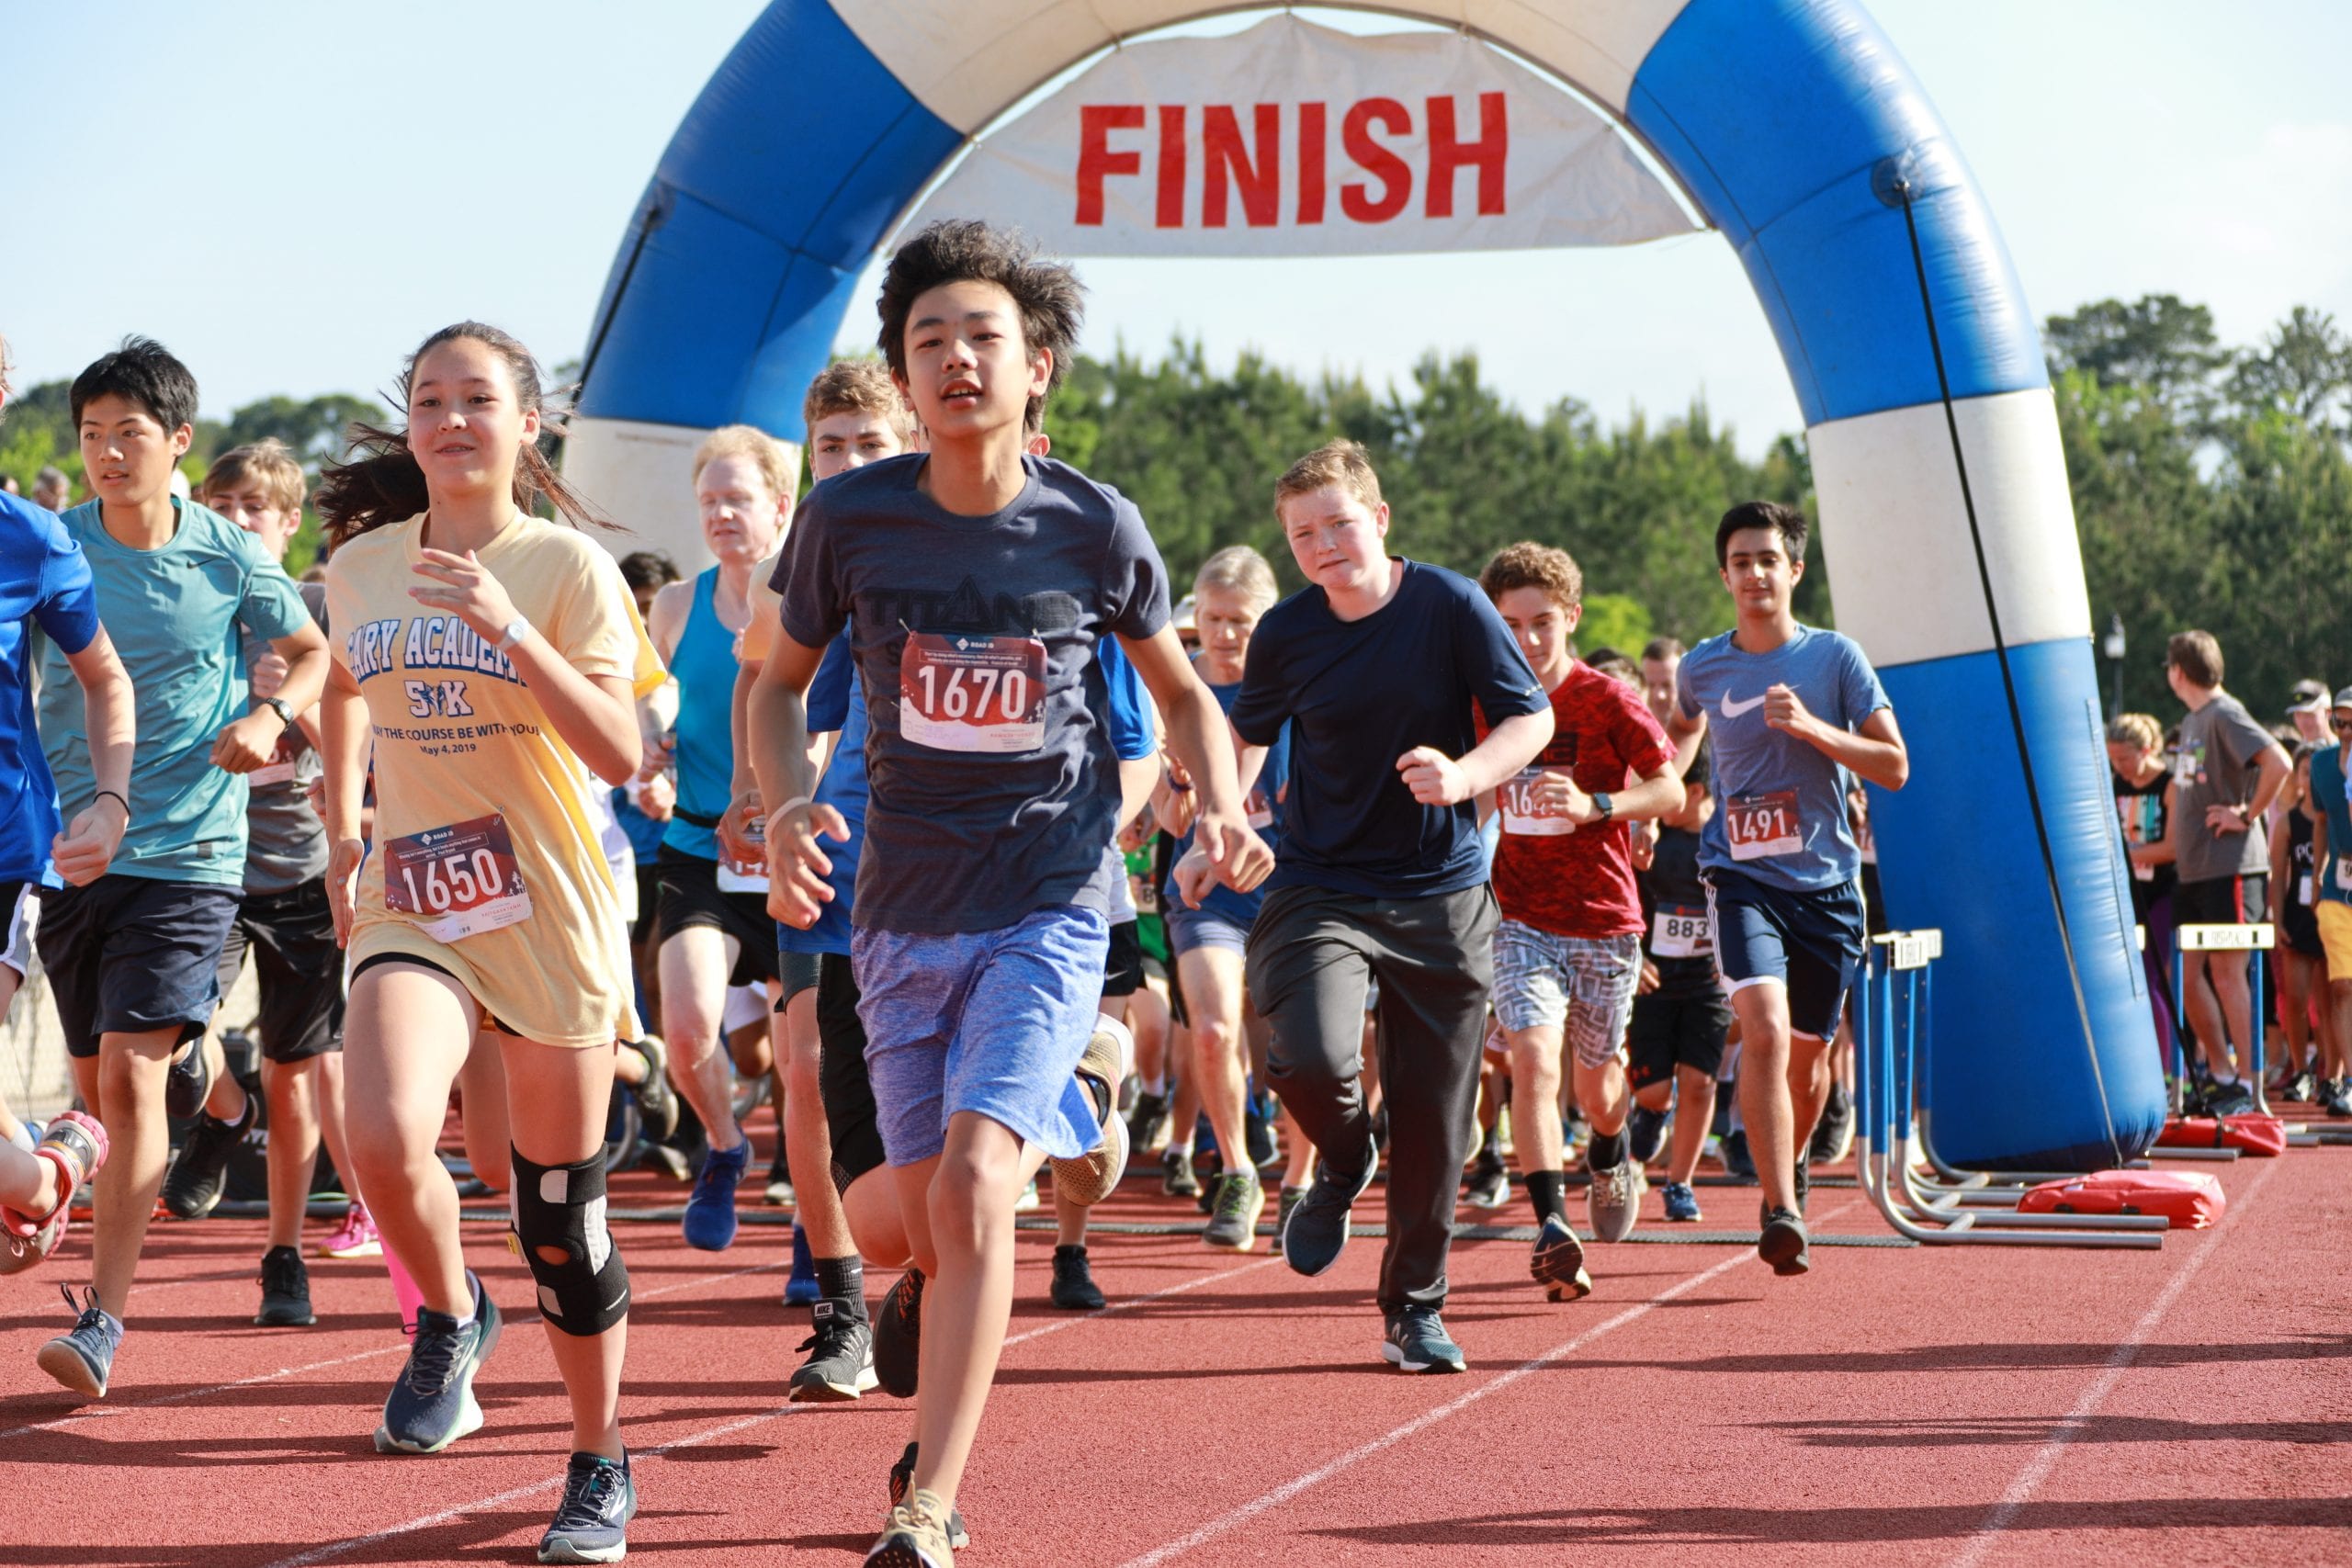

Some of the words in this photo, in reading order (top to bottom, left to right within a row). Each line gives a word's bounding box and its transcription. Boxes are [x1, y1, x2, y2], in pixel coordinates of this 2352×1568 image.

[1075, 92, 1509, 229] FINISH
[403, 615, 528, 688] ACADEM
[919, 665, 1027, 720] 1670
[383, 727, 405, 739] THE
[405, 728, 456, 741] COURSE
[458, 727, 474, 739] BE
[419, 745, 439, 757] May
[452, 743, 477, 753] 2019
[1728, 808, 1787, 842] 1491
[402, 848, 503, 914] 1650
[1667, 919, 1708, 938] 883
